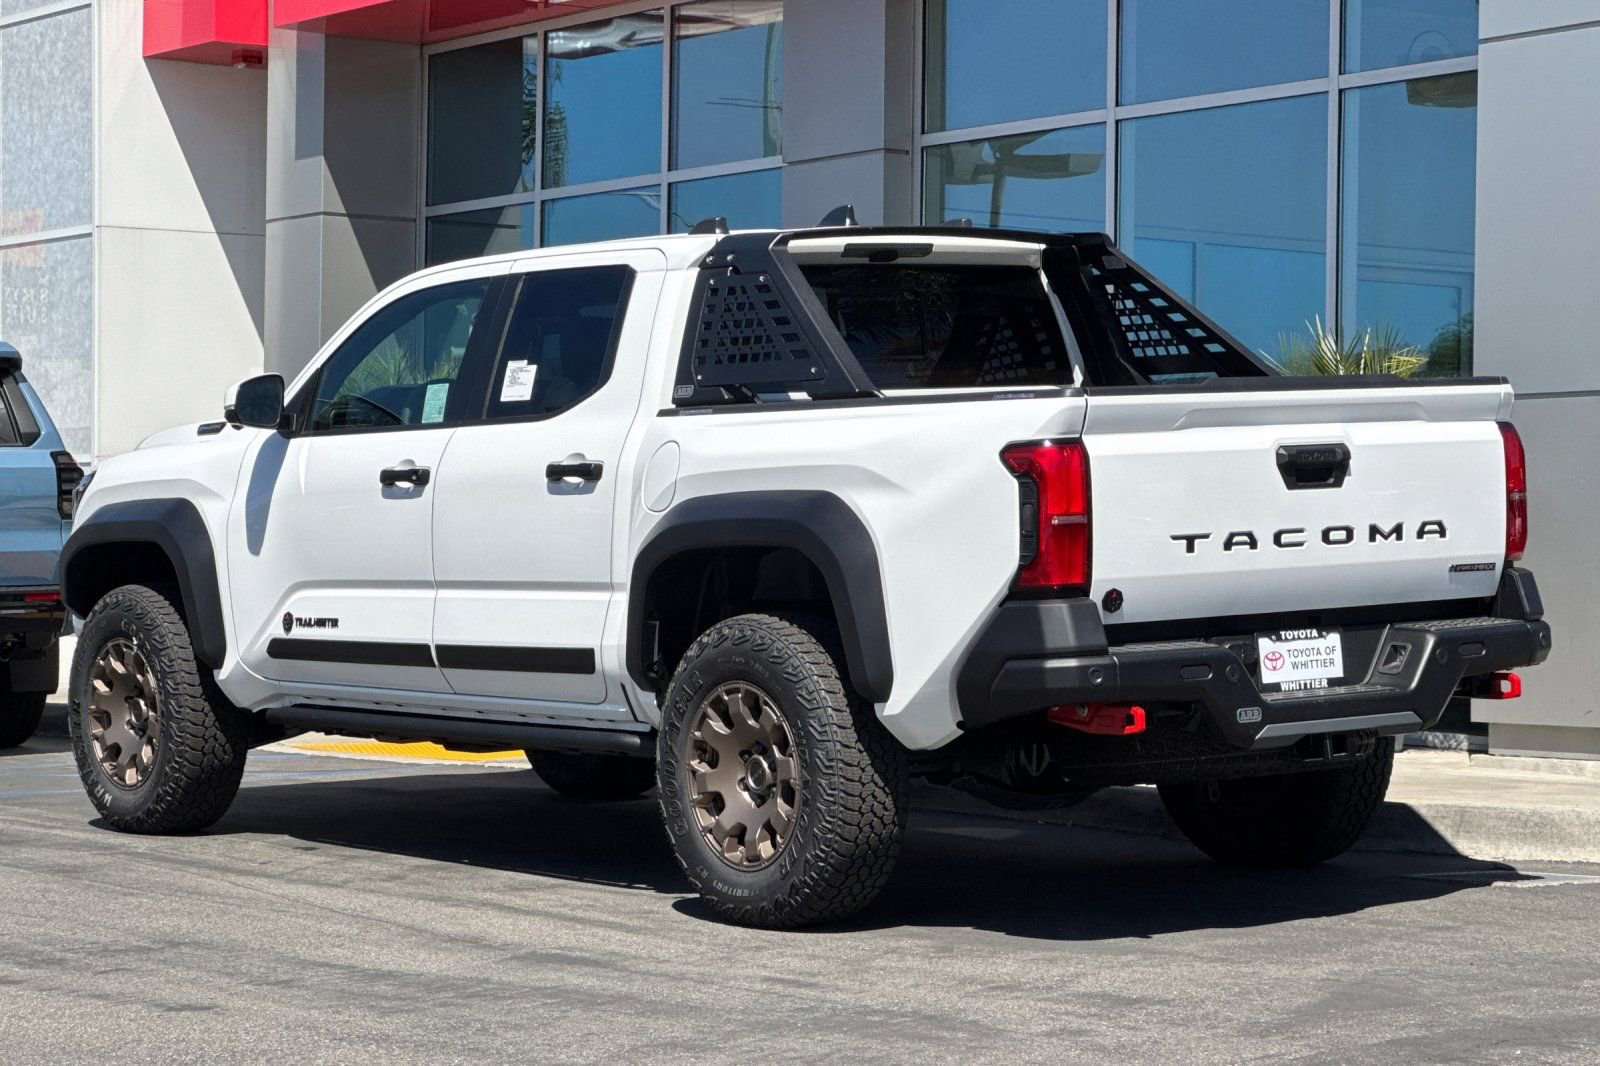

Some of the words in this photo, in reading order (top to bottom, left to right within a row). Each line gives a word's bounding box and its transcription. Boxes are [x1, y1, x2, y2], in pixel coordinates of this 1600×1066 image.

[1169, 519, 1448, 554] TACOMA
[1280, 629, 1319, 640] TOYOTA
[1287, 647, 1322, 659] TOYOTA
[1324, 645, 1337, 656] OF
[1291, 658, 1335, 671] WHITTIER
[1280, 678, 1329, 692] WHITTIER
[1239, 709, 1261, 721] ARB
